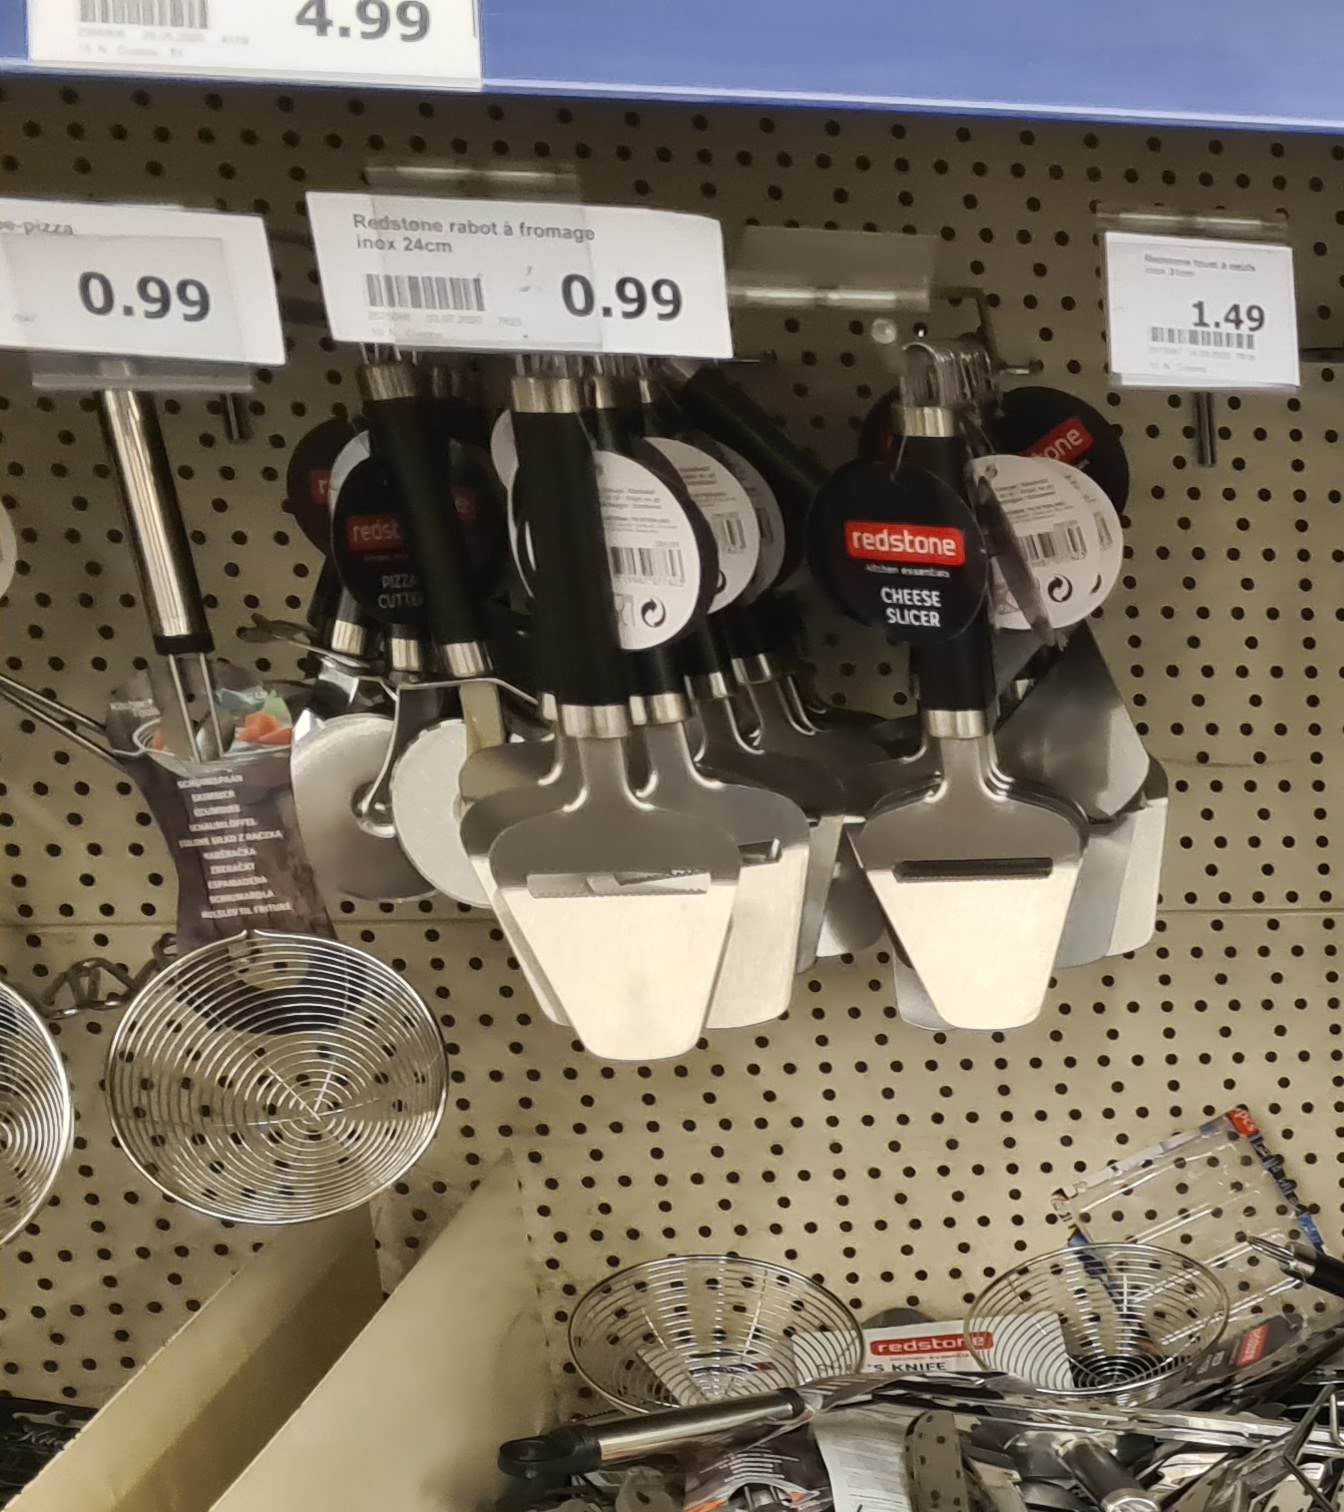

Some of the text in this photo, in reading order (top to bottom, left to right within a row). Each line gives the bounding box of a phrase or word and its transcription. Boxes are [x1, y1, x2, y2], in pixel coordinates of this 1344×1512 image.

[296, 0, 430, 42] 4.99
[353, 214, 595, 243] Redstone rabot à fromage
[357, 235, 452, 253] inox 24cm
[78, 271, 210, 322] 0.99
[561, 273, 683, 321] 0.99
[1192, 300, 1265, 332] 1.49
[852, 529, 957, 557] redstone
[881, 587, 941, 608] CHEESE
[886, 608, 941, 628] SLICER
[878, 1335, 985, 1353] redstone
[891, 1361, 946, 1373] KNIFE
